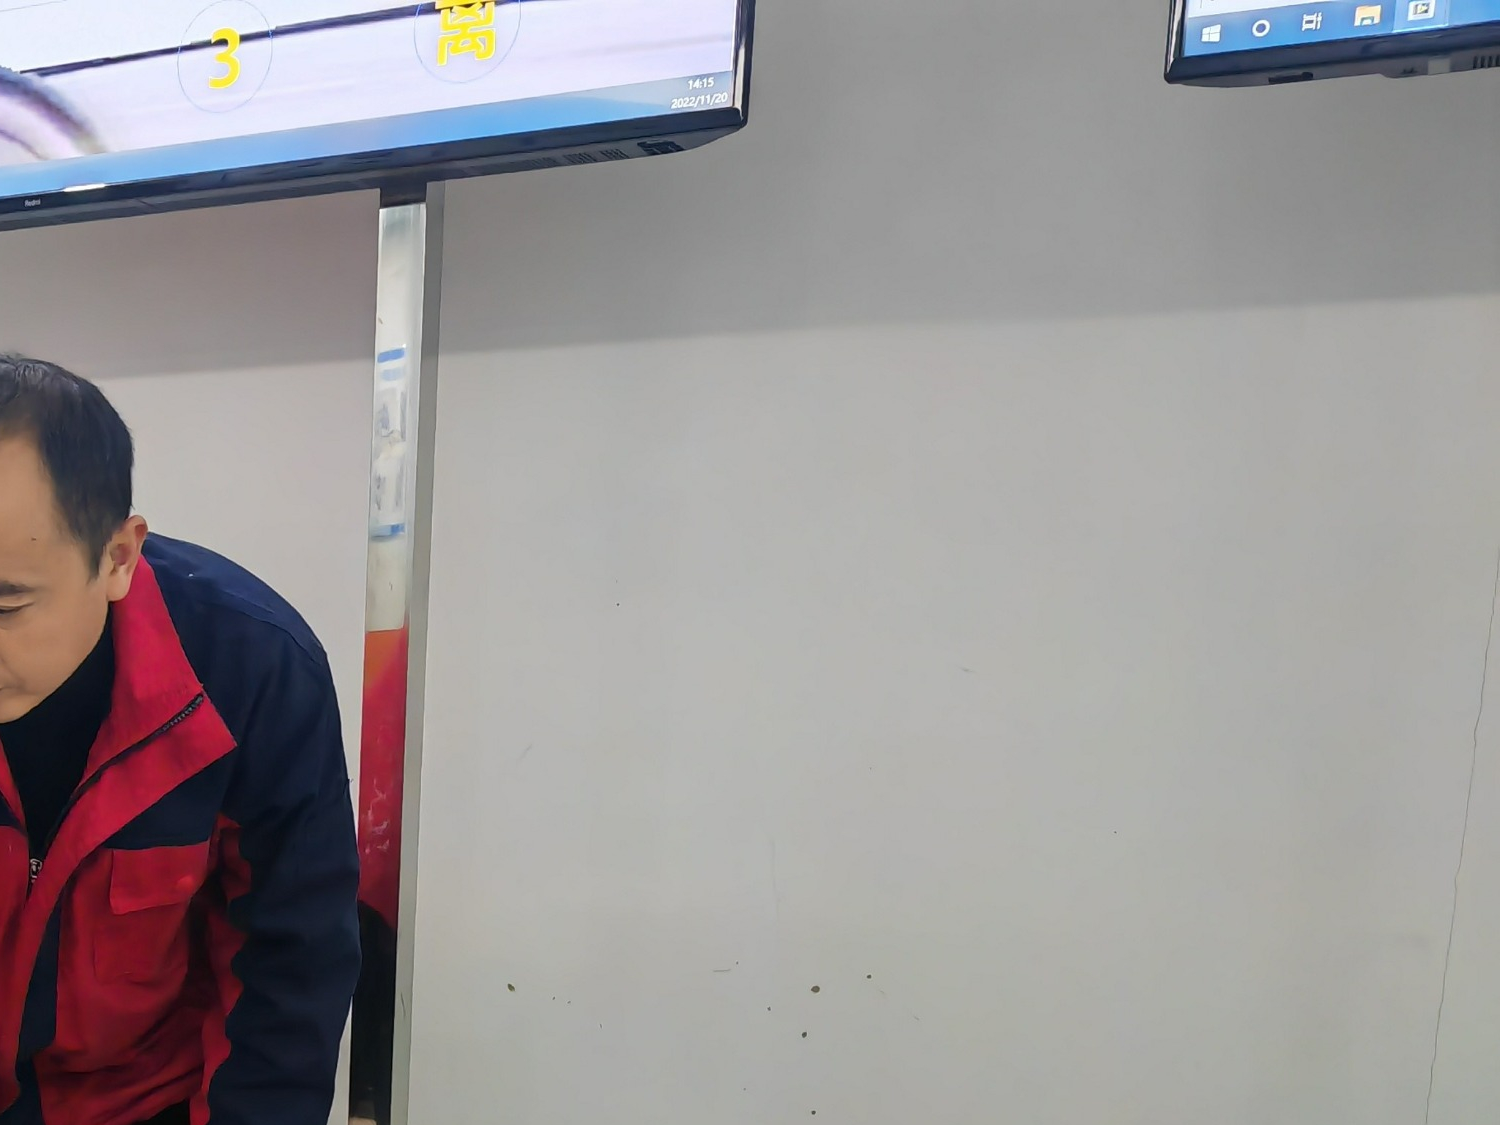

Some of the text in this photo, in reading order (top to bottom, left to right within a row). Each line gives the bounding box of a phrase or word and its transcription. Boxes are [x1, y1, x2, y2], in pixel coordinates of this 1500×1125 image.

[435, 0, 496, 66] 离
[209, 27, 241, 89] 3
[670, 92, 729, 109] 2022/11/20
[687, 77, 715, 90] 14:15
